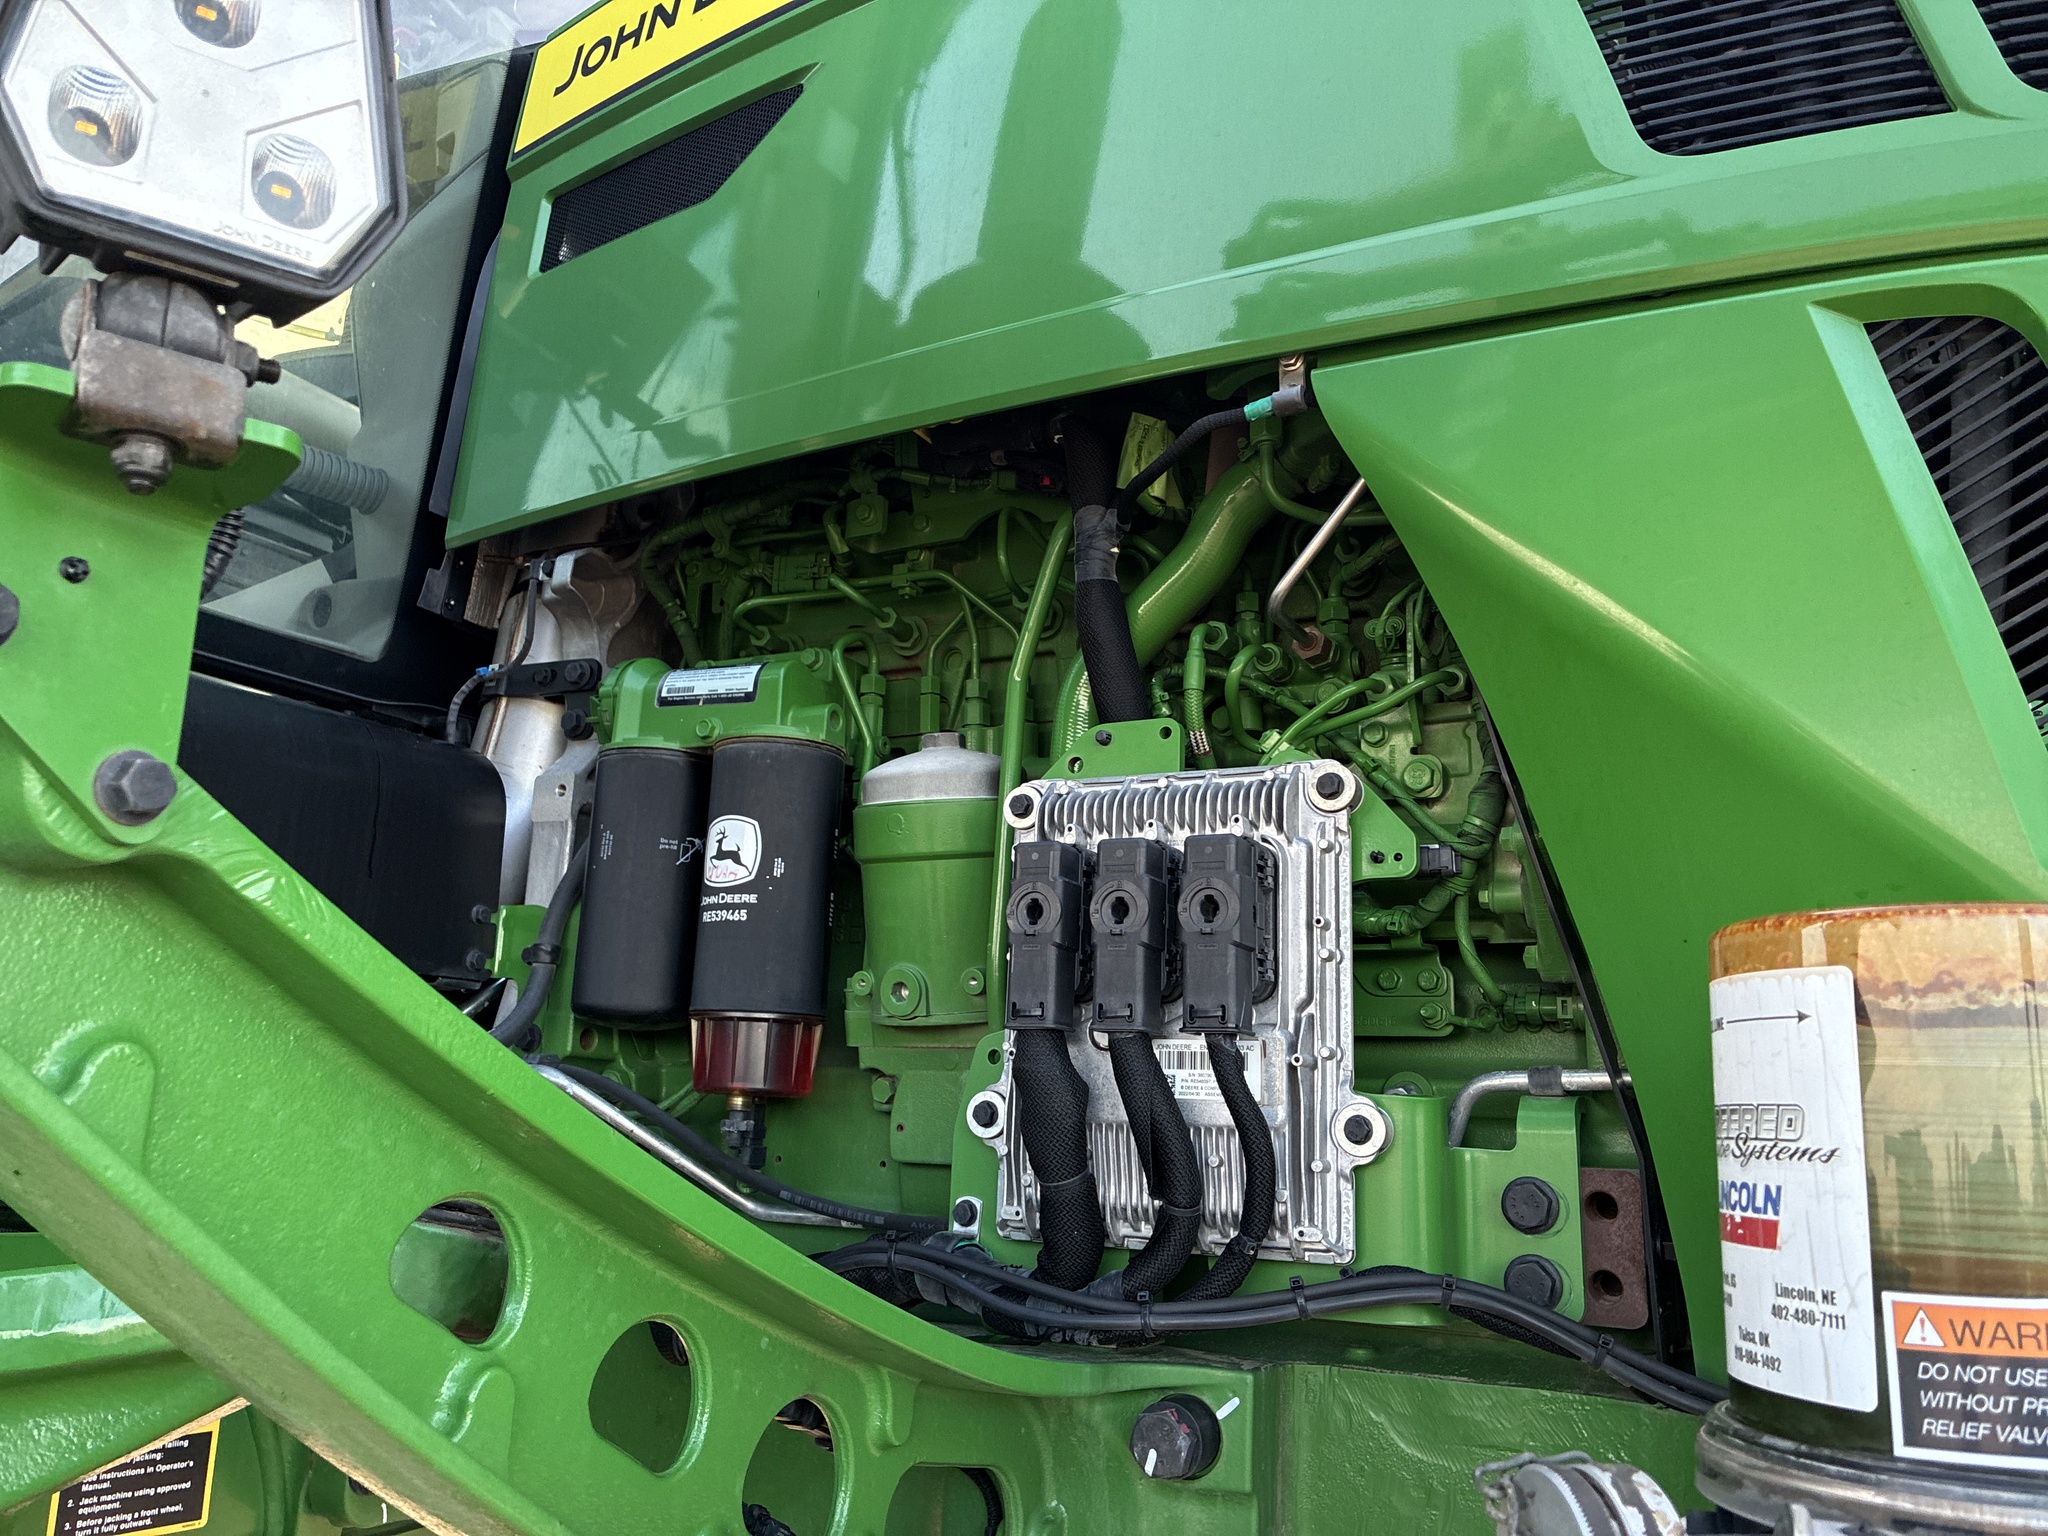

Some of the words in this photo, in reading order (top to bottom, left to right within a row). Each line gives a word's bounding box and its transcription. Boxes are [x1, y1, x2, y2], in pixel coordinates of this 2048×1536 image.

[553, 0, 681, 97] JOHN
[701, 895, 718, 906] JOHN
[719, 893, 758, 904] DEERE
[702, 909, 748, 922] RE539465
[1172, 1043, 1192, 1051] DEERE
[1715, 1103, 1804, 1142] EERED
[1731, 1132, 1843, 1169] Systems
[1775, 1282, 1819, 1305] Lincoln,
[1821, 1289, 1838, 1306] NE
[1771, 1303, 1847, 1331] 402-480-7111
[1949, 1318, 2048, 1351] WAR
[1917, 1361, 1950, 1381] DO
[1953, 1364, 2001, 1385] NOT
[2004, 1367, 2048, 1388] USE
[1920, 1389, 2019, 1415] WITHOUT
[1922, 1418, 1992, 1441] RELIEF
[1995, 1424, 2048, 1446] VALV
[99, 1468, 145, 1481] instructions
[147, 1465, 154, 1474] in
[156, 1460, 194, 1473] Operator's
[67, 1499, 75, 1507] 2.
[79, 1495, 98, 1506] Jack
[100, 1490, 133, 1502] machine
[134, 1487, 155, 1499] using
[156, 1481, 192, 1495] approved
[81, 1480, 112, 1492] Manual.
[64, 1522, 72, 1531] 3.
[76, 1518, 103, 1529] Before
[104, 1512, 133, 1526] jacking
[133, 1511, 139, 1519] a
[140, 1508, 159, 1518] front
[160, 1503, 184, 1515] wheel,
[78, 1501, 122, 1516] equipment.
[101, 1523, 119, 1533] fully
[120, 1518, 153, 1531] outward.
